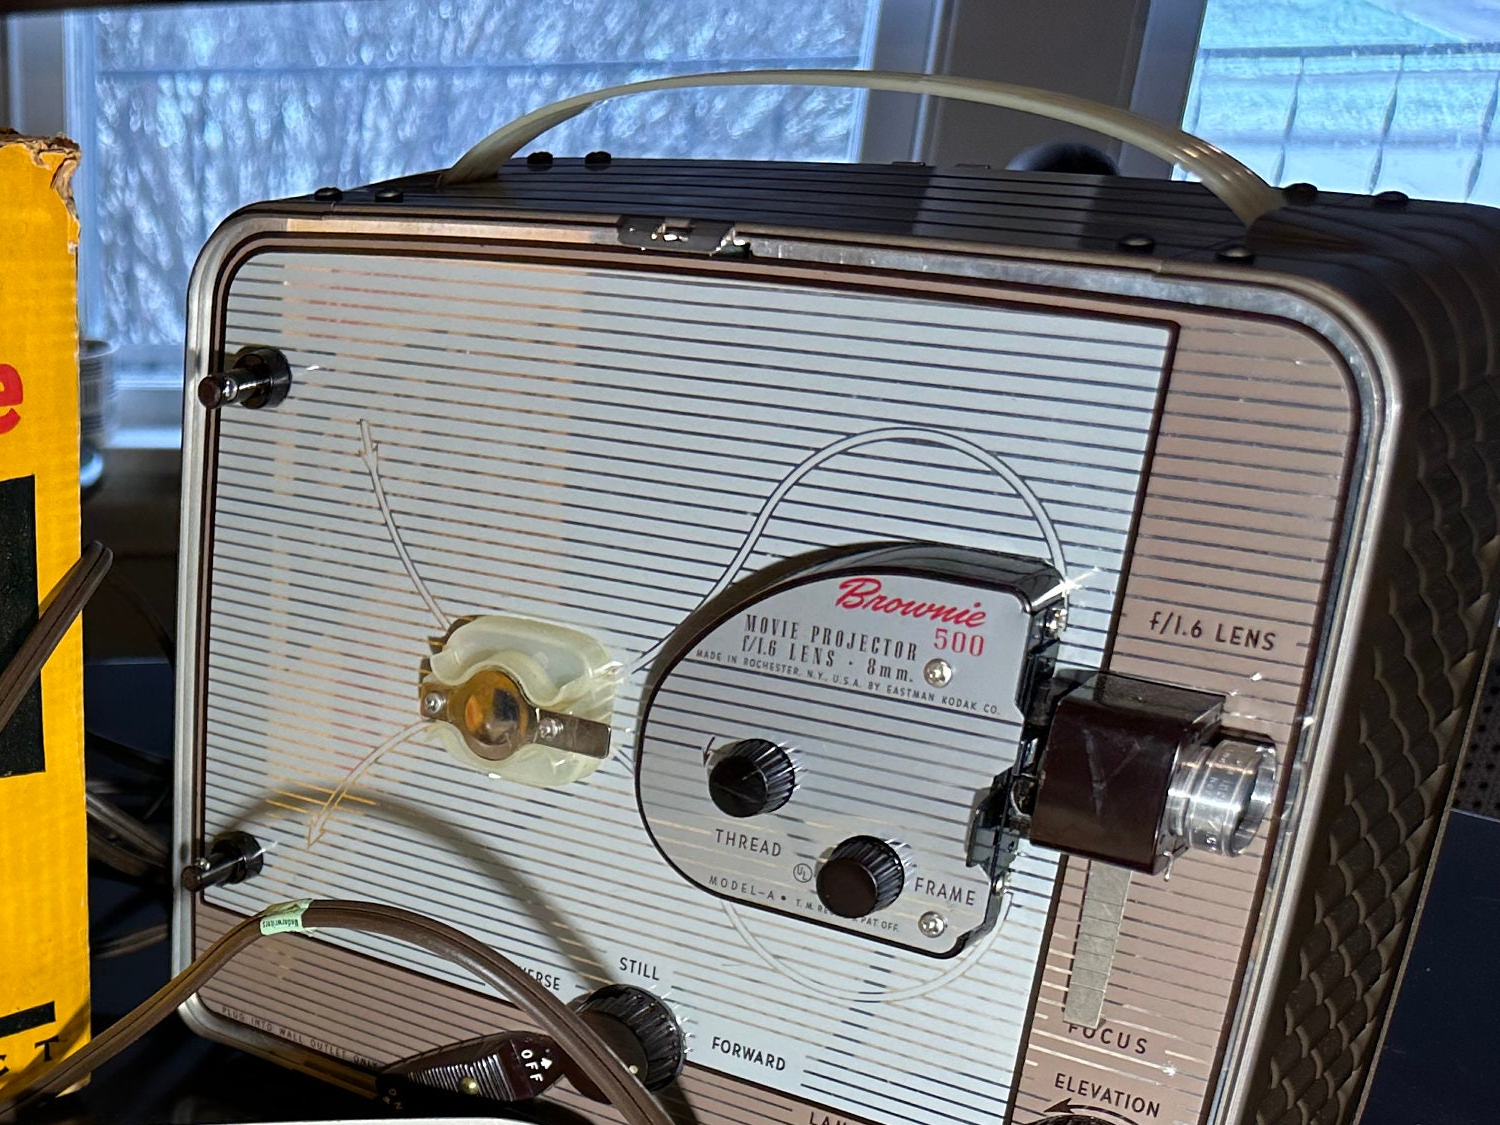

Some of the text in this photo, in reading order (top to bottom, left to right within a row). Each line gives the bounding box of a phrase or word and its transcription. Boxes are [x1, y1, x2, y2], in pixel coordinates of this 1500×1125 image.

[835, 577, 987, 628] Brownie
[744, 614, 917, 661] MOVIE PROJECTOR
[789, 640, 835, 668] LENS
[933, 629, 985, 657] 500
[1215, 623, 1276, 651] LENS
[696, 648, 722, 662] MADE
[727, 653, 738, 665] IN
[867, 681, 881, 692] BY
[886, 684, 936, 704] EASTMAN
[941, 696, 977, 712] KODAK
[983, 703, 1001, 717] CO.
[716, 829, 781, 857] THREAD
[914, 877, 977, 906] FRAME
[619, 957, 660, 981] STILL
[251, 1018, 273, 1033] INTO
[278, 1027, 303, 1044] WALL
[309, 1038, 347, 1059] OUTLET
[711, 1037, 786, 1071] FORWARD
[521, 1049, 543, 1083] OFF
[1055, 1072, 1160, 1119] ELEVATION
